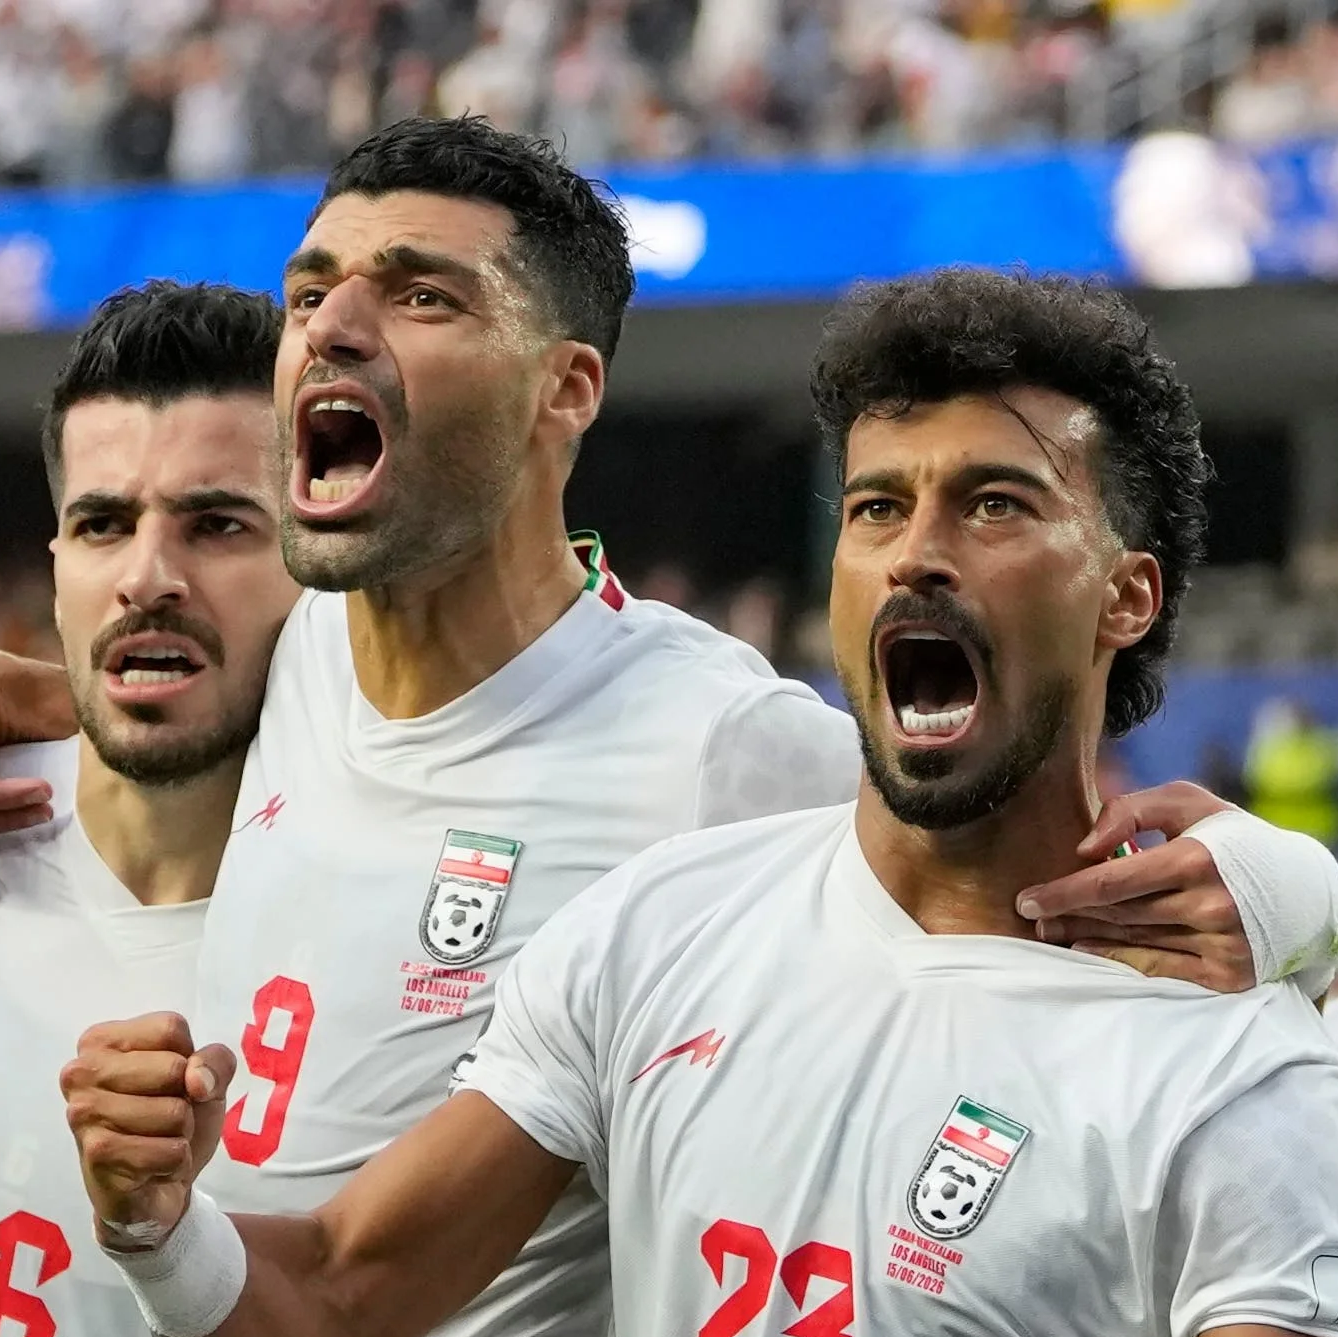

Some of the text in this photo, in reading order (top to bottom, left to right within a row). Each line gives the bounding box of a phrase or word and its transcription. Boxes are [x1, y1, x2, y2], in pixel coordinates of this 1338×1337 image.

[406, 978, 425, 993] LOS
[220, 974, 315, 1167] 9
[891, 1243, 947, 1277] LOS ANGELES
[887, 1262, 945, 1294] 15/06/2026
